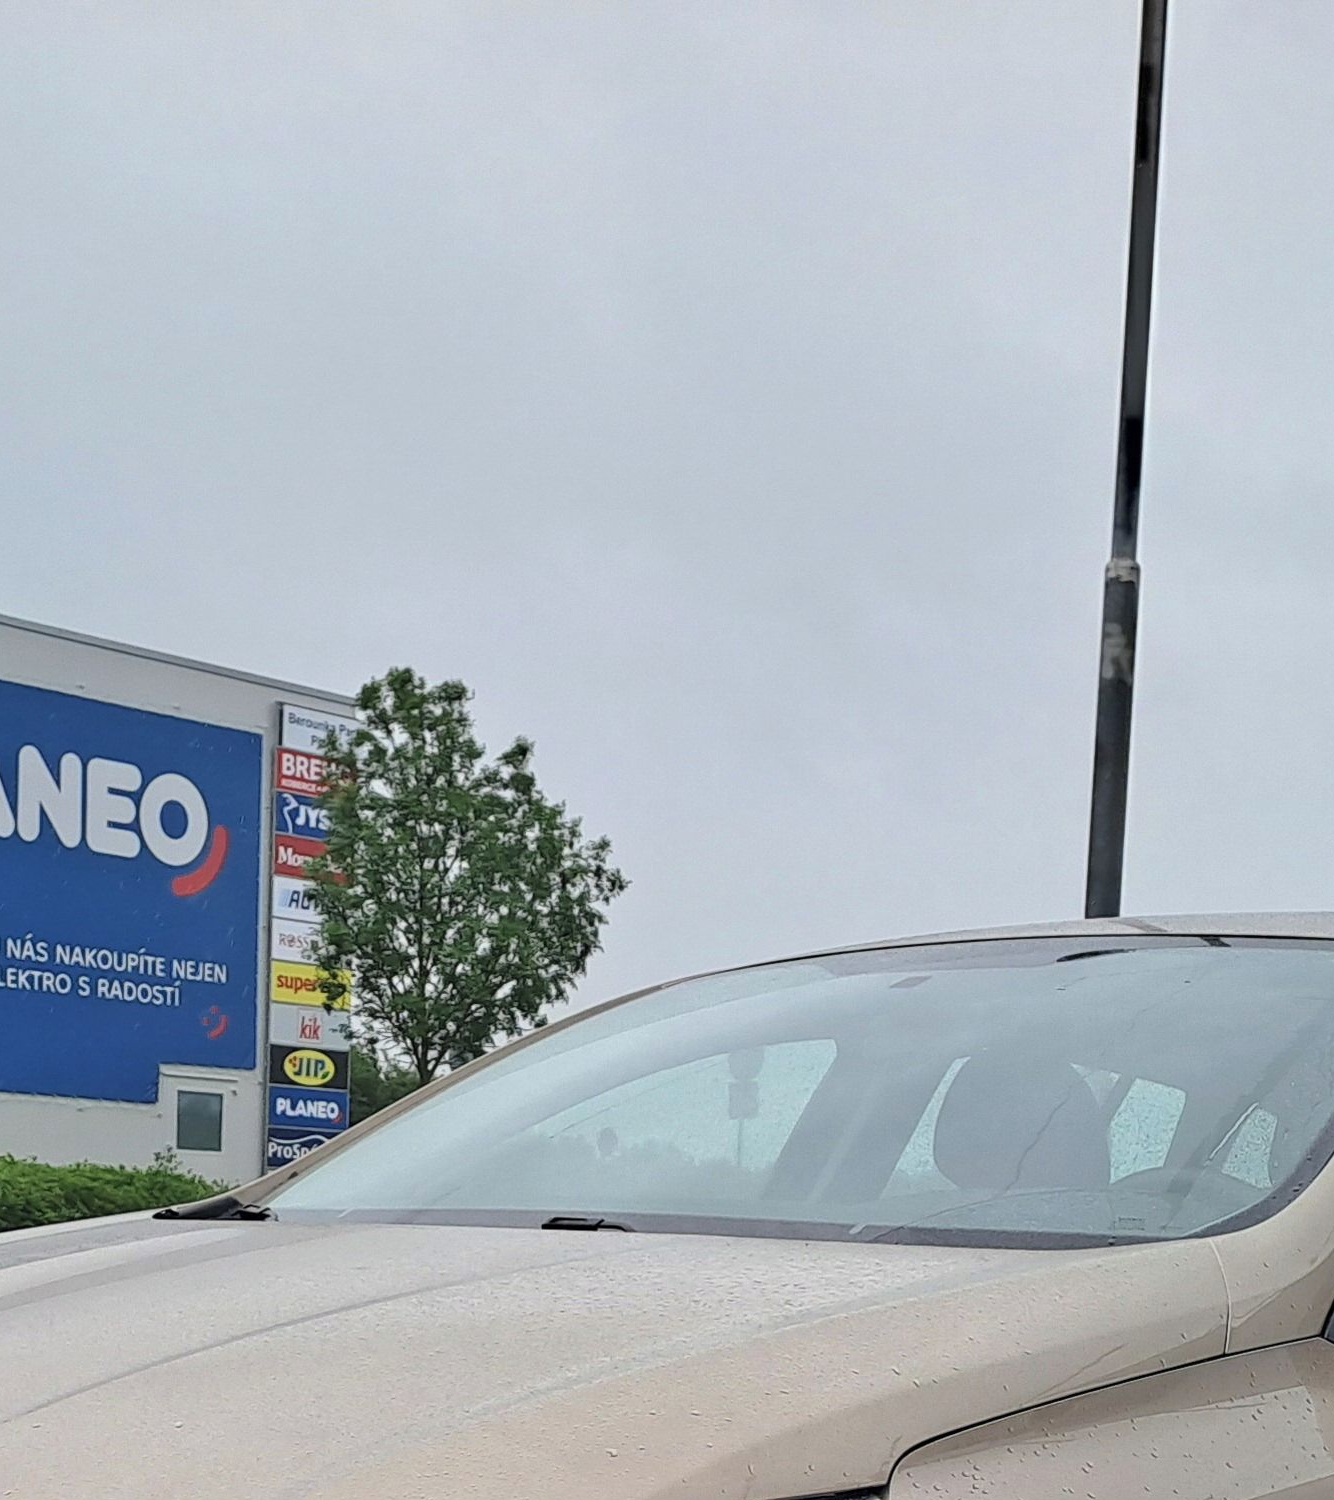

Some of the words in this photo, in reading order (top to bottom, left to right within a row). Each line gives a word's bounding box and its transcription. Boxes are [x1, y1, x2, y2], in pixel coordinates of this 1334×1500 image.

[295, 805, 333, 831] JYS
[7, 933, 48, 962] NÁS
[56, 944, 166, 977] NAKOUPÍTE
[172, 959, 227, 984] NEJEN
[78, 977, 91, 997] S
[97, 979, 181, 1007] RADOSTÍ
[299, 1016, 321, 1040] kik
[293, 1057, 326, 1078] JIP
[276, 1097, 339, 1119] PLANEO
